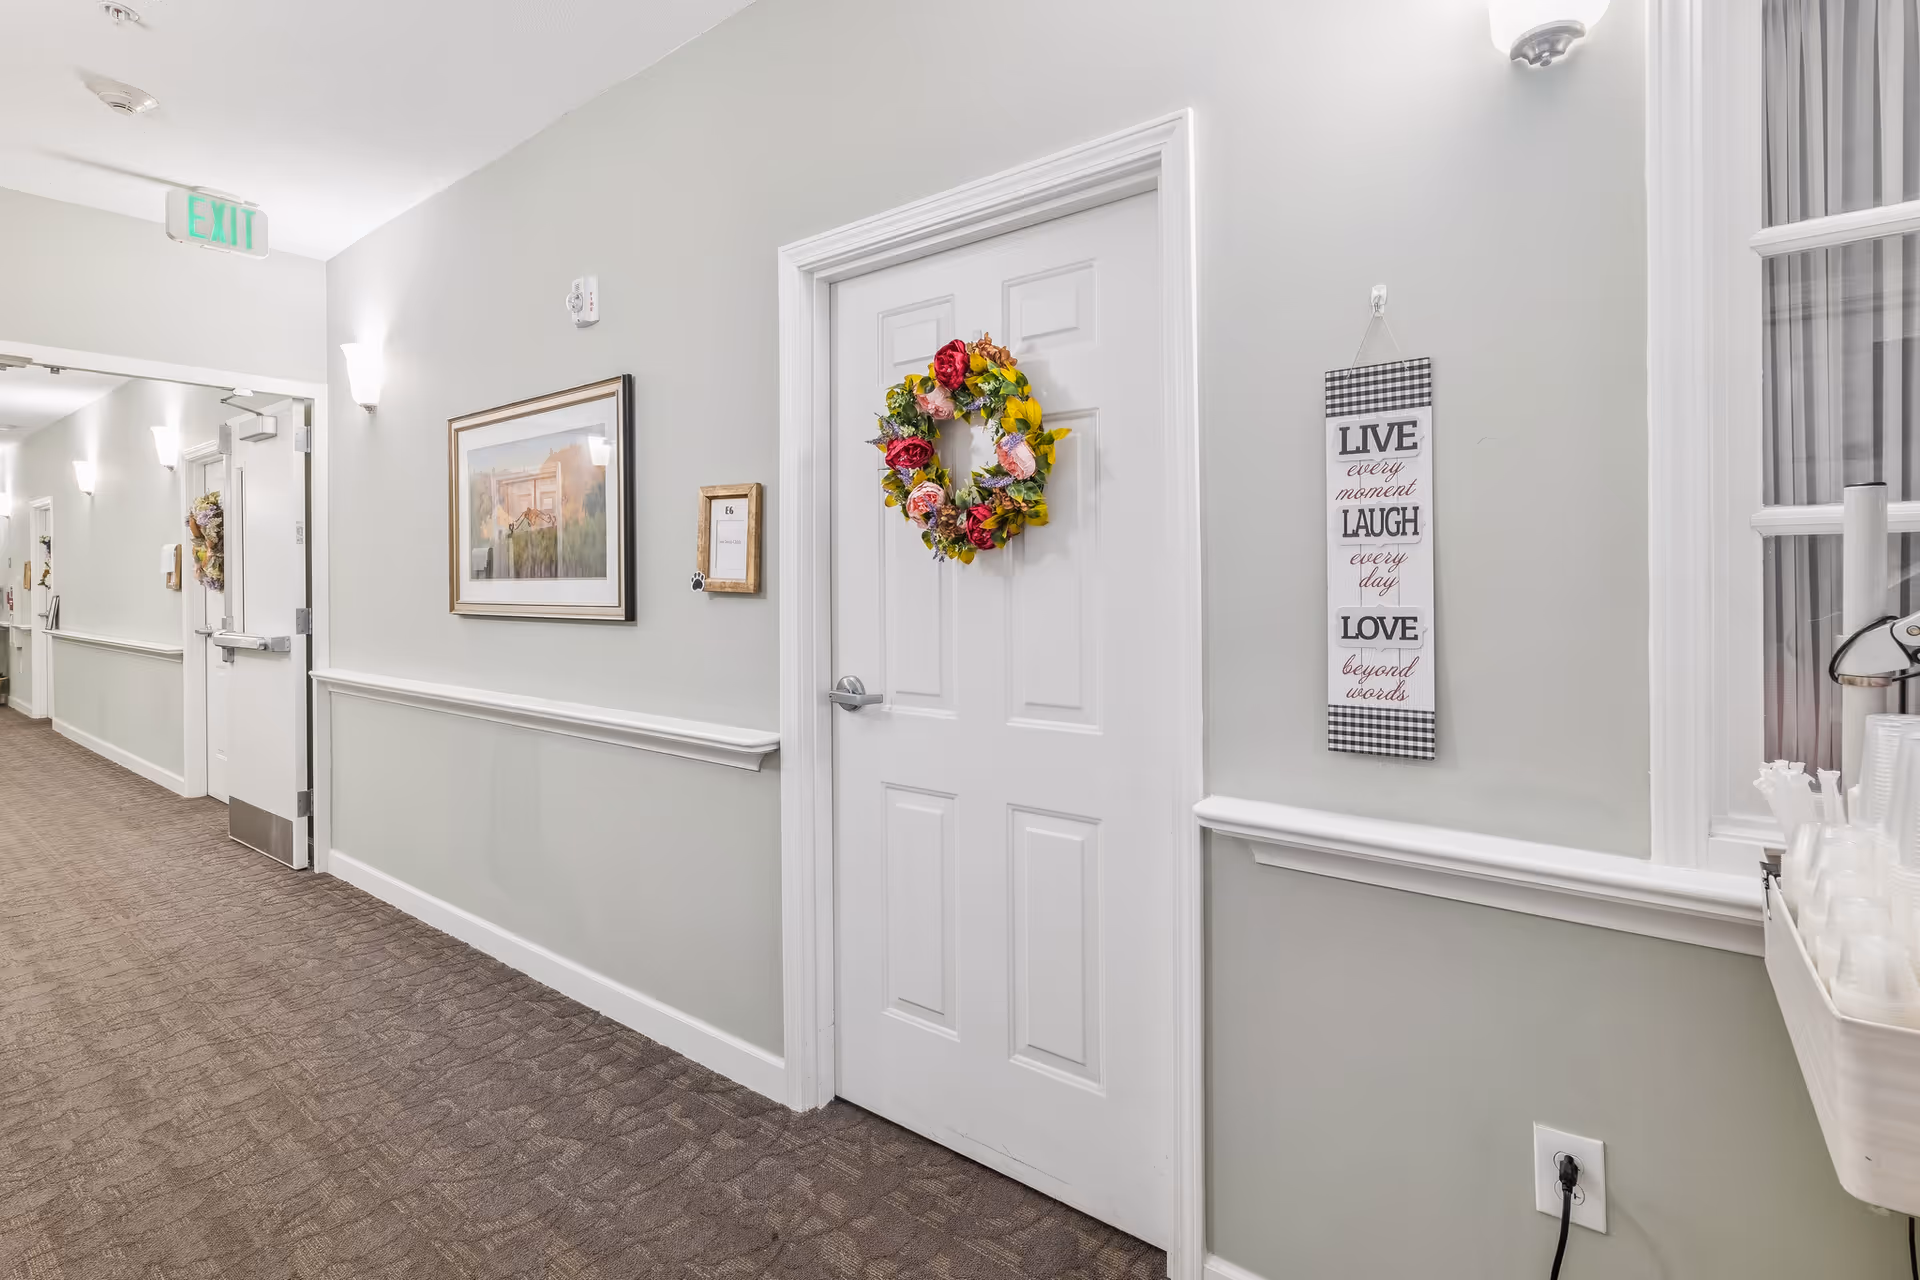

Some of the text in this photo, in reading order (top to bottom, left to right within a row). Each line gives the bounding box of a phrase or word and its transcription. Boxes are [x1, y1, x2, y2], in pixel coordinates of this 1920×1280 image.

[188, 195, 256, 249] EXIT
[1339, 420, 1418, 455] LIVE
[1347, 461, 1405, 482] every
[1335, 478, 1417, 500] moment
[725, 506, 734, 515] E6
[1342, 506, 1419, 537] LAUGH
[1350, 552, 1408, 573] every
[1359, 566, 1399, 596] day
[1341, 616, 1418, 640] LOVE
[1342, 654, 1420, 684] beyond
[1346, 680, 1409, 701] words
